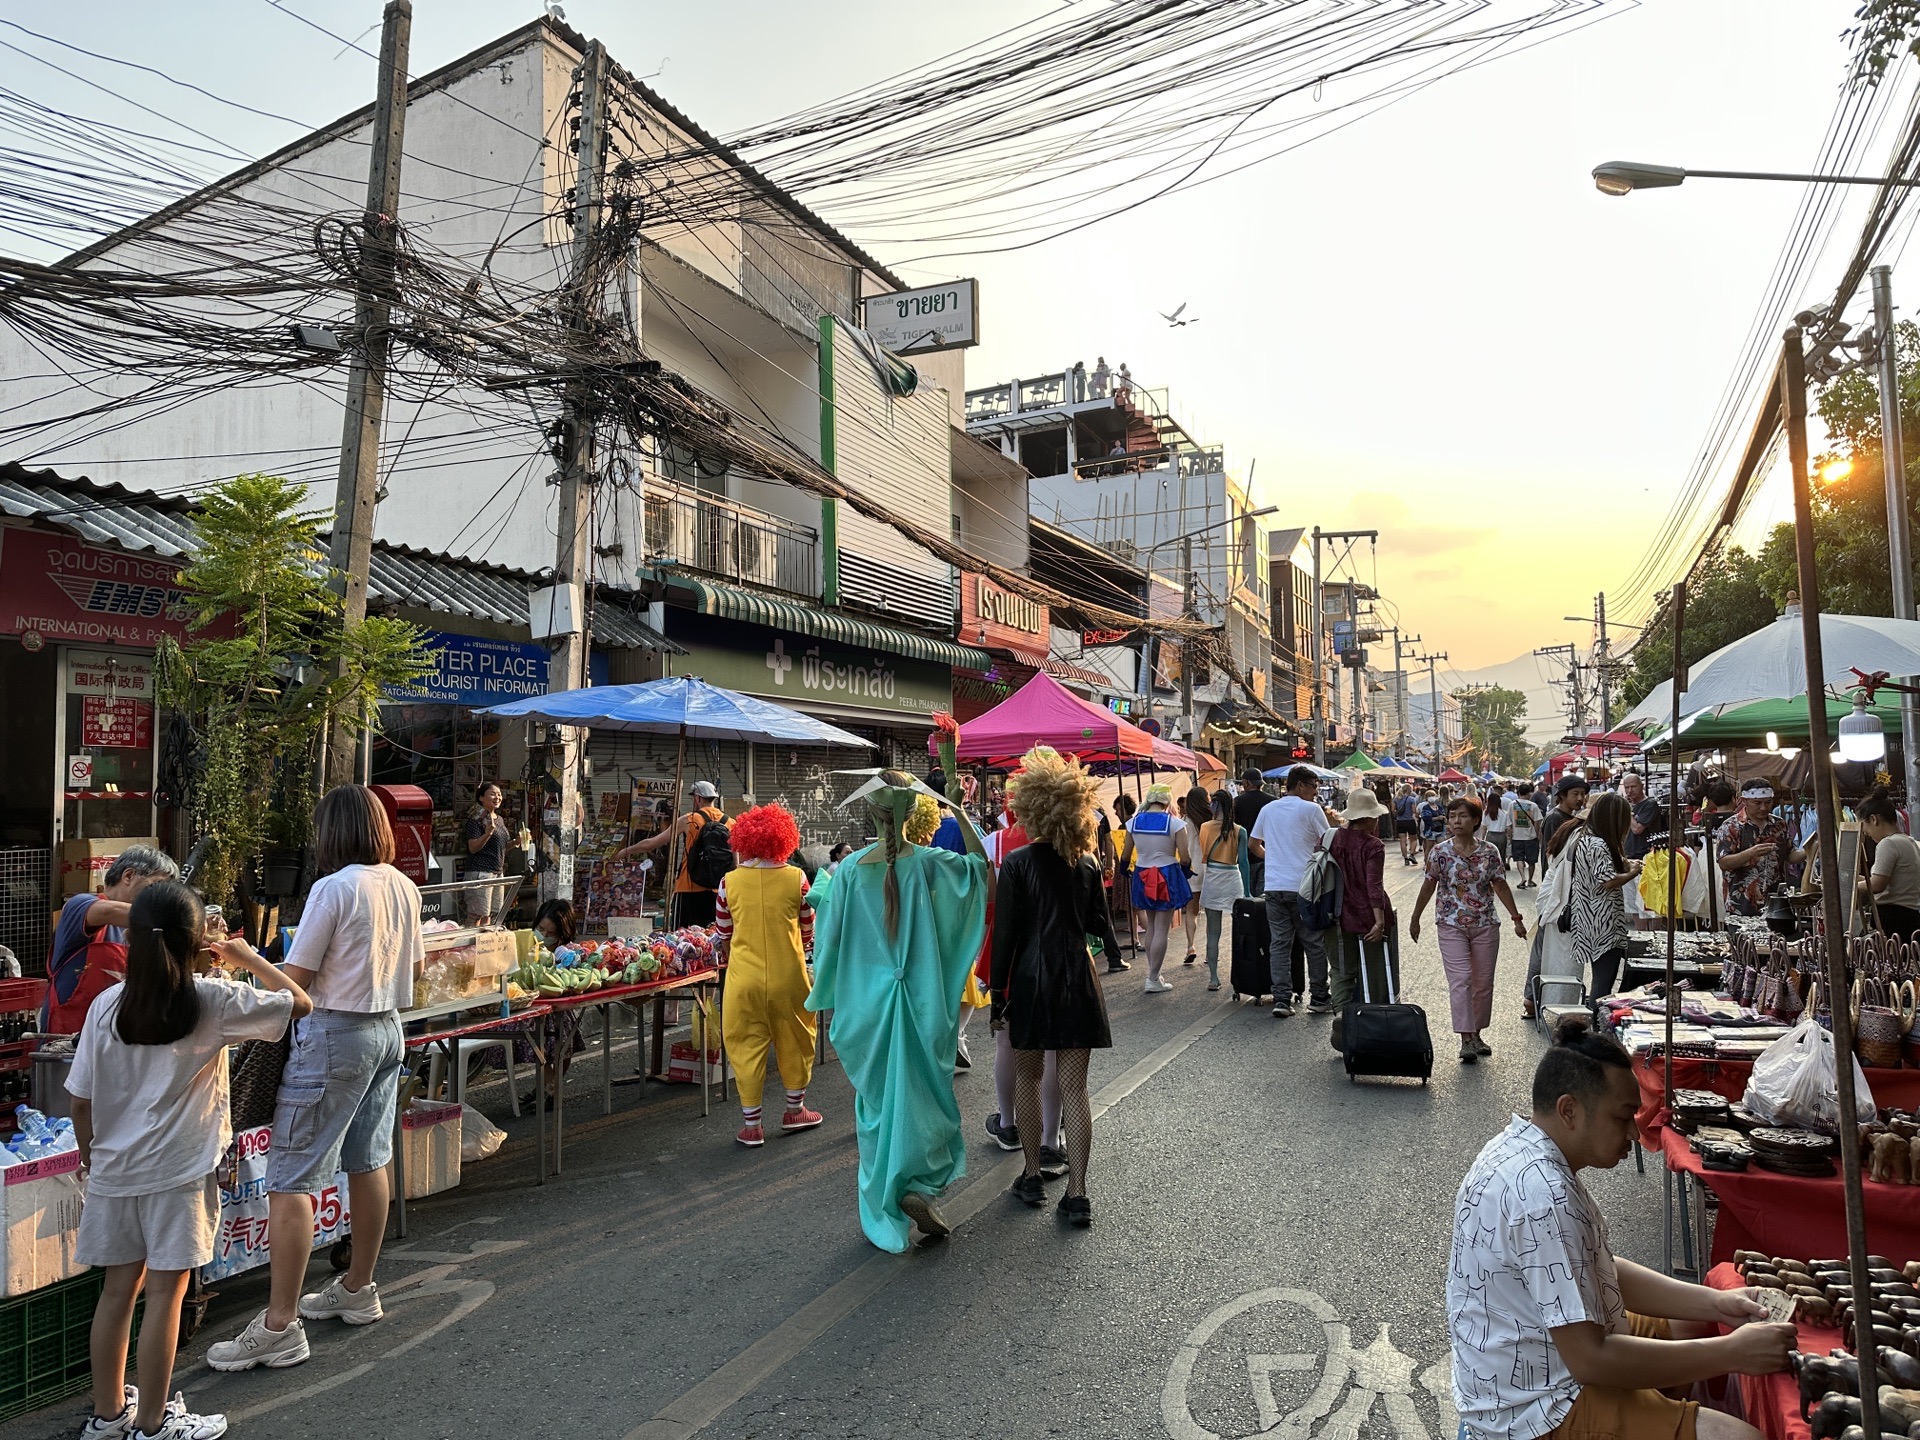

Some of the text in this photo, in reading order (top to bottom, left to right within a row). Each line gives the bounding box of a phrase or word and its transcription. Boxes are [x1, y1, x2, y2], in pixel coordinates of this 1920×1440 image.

[896, 291, 958, 318] ขายยา
[85, 580, 166, 618] EMS
[15, 615, 127, 639] INTERNATIONAL
[129, 627, 141, 640] &
[115, 664, 129, 673] Post
[480, 653, 537, 679] PLACE
[424, 674, 551, 701] TOURIST INFORMATI
[448, 692, 459, 701] RD
[899, 696, 951, 711] PEERA PHARMACY
